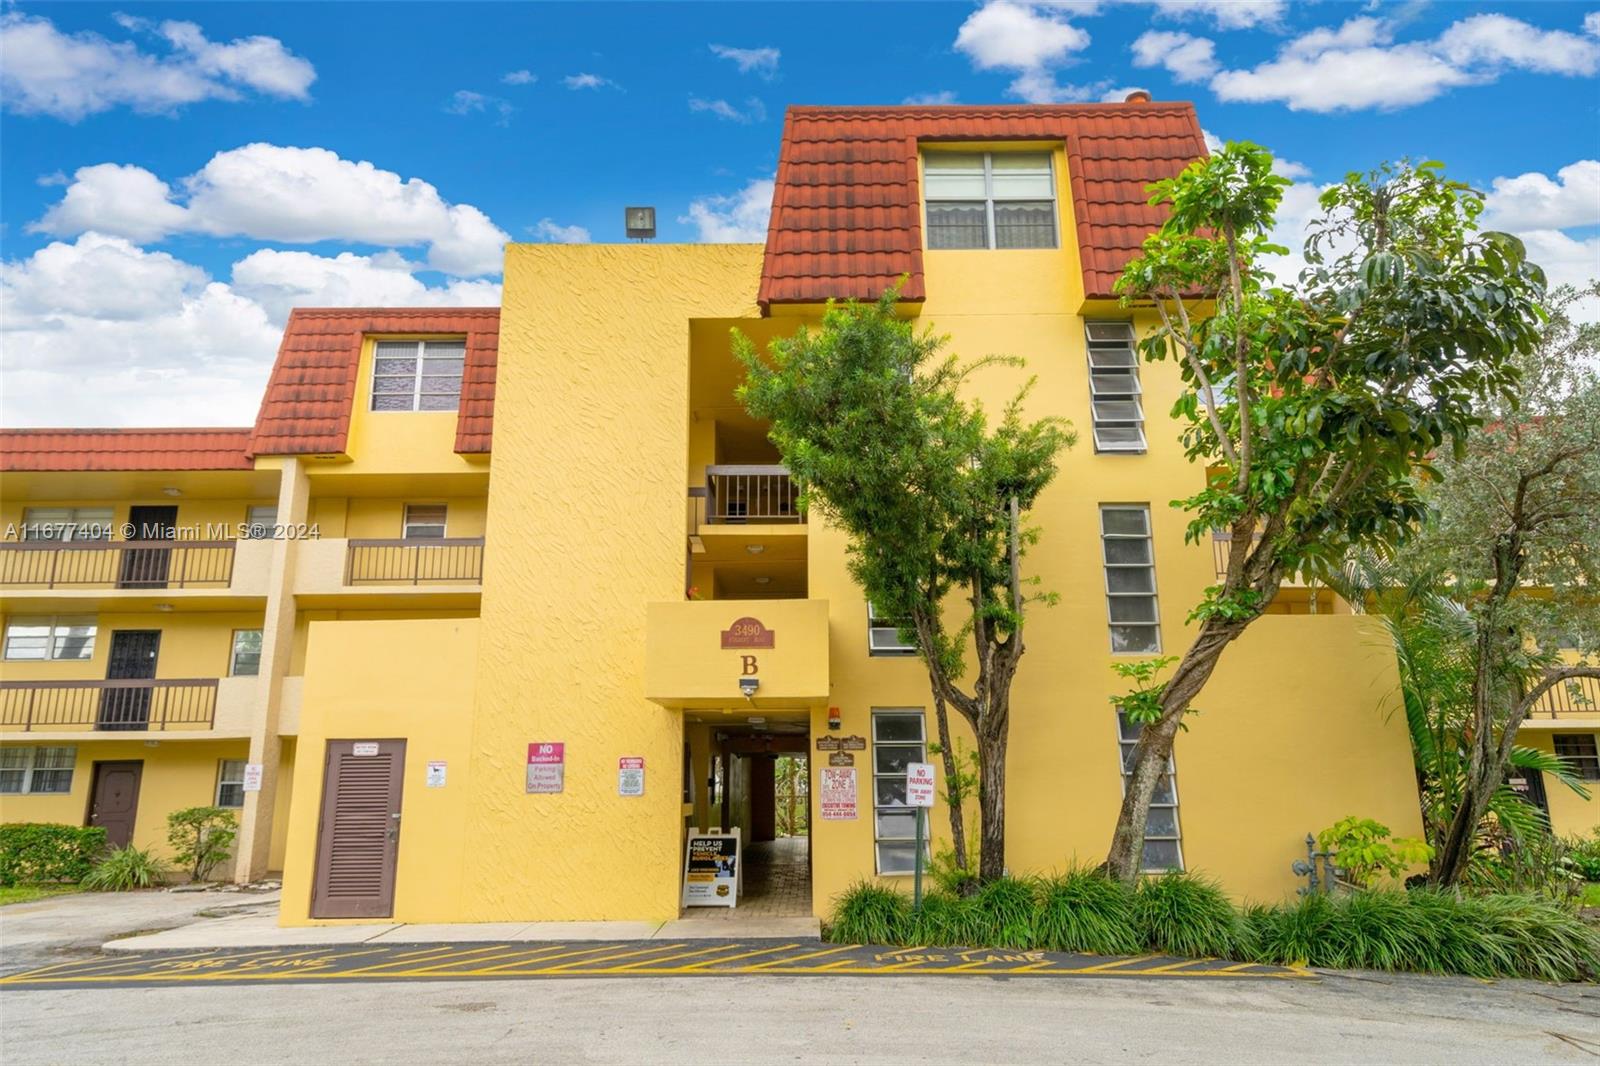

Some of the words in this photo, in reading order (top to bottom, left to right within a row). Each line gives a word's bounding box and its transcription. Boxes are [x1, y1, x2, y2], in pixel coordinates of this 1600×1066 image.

[735, 624, 760, 636] 3490
[740, 655, 758, 675] B
[539, 744, 553, 754] NO
[916, 769, 926, 777] NO
[831, 779, 847, 789] ZONE
[909, 777, 932, 785] PARKING
[874, 954, 950, 962] FIRE
[960, 952, 1044, 962] LANE
